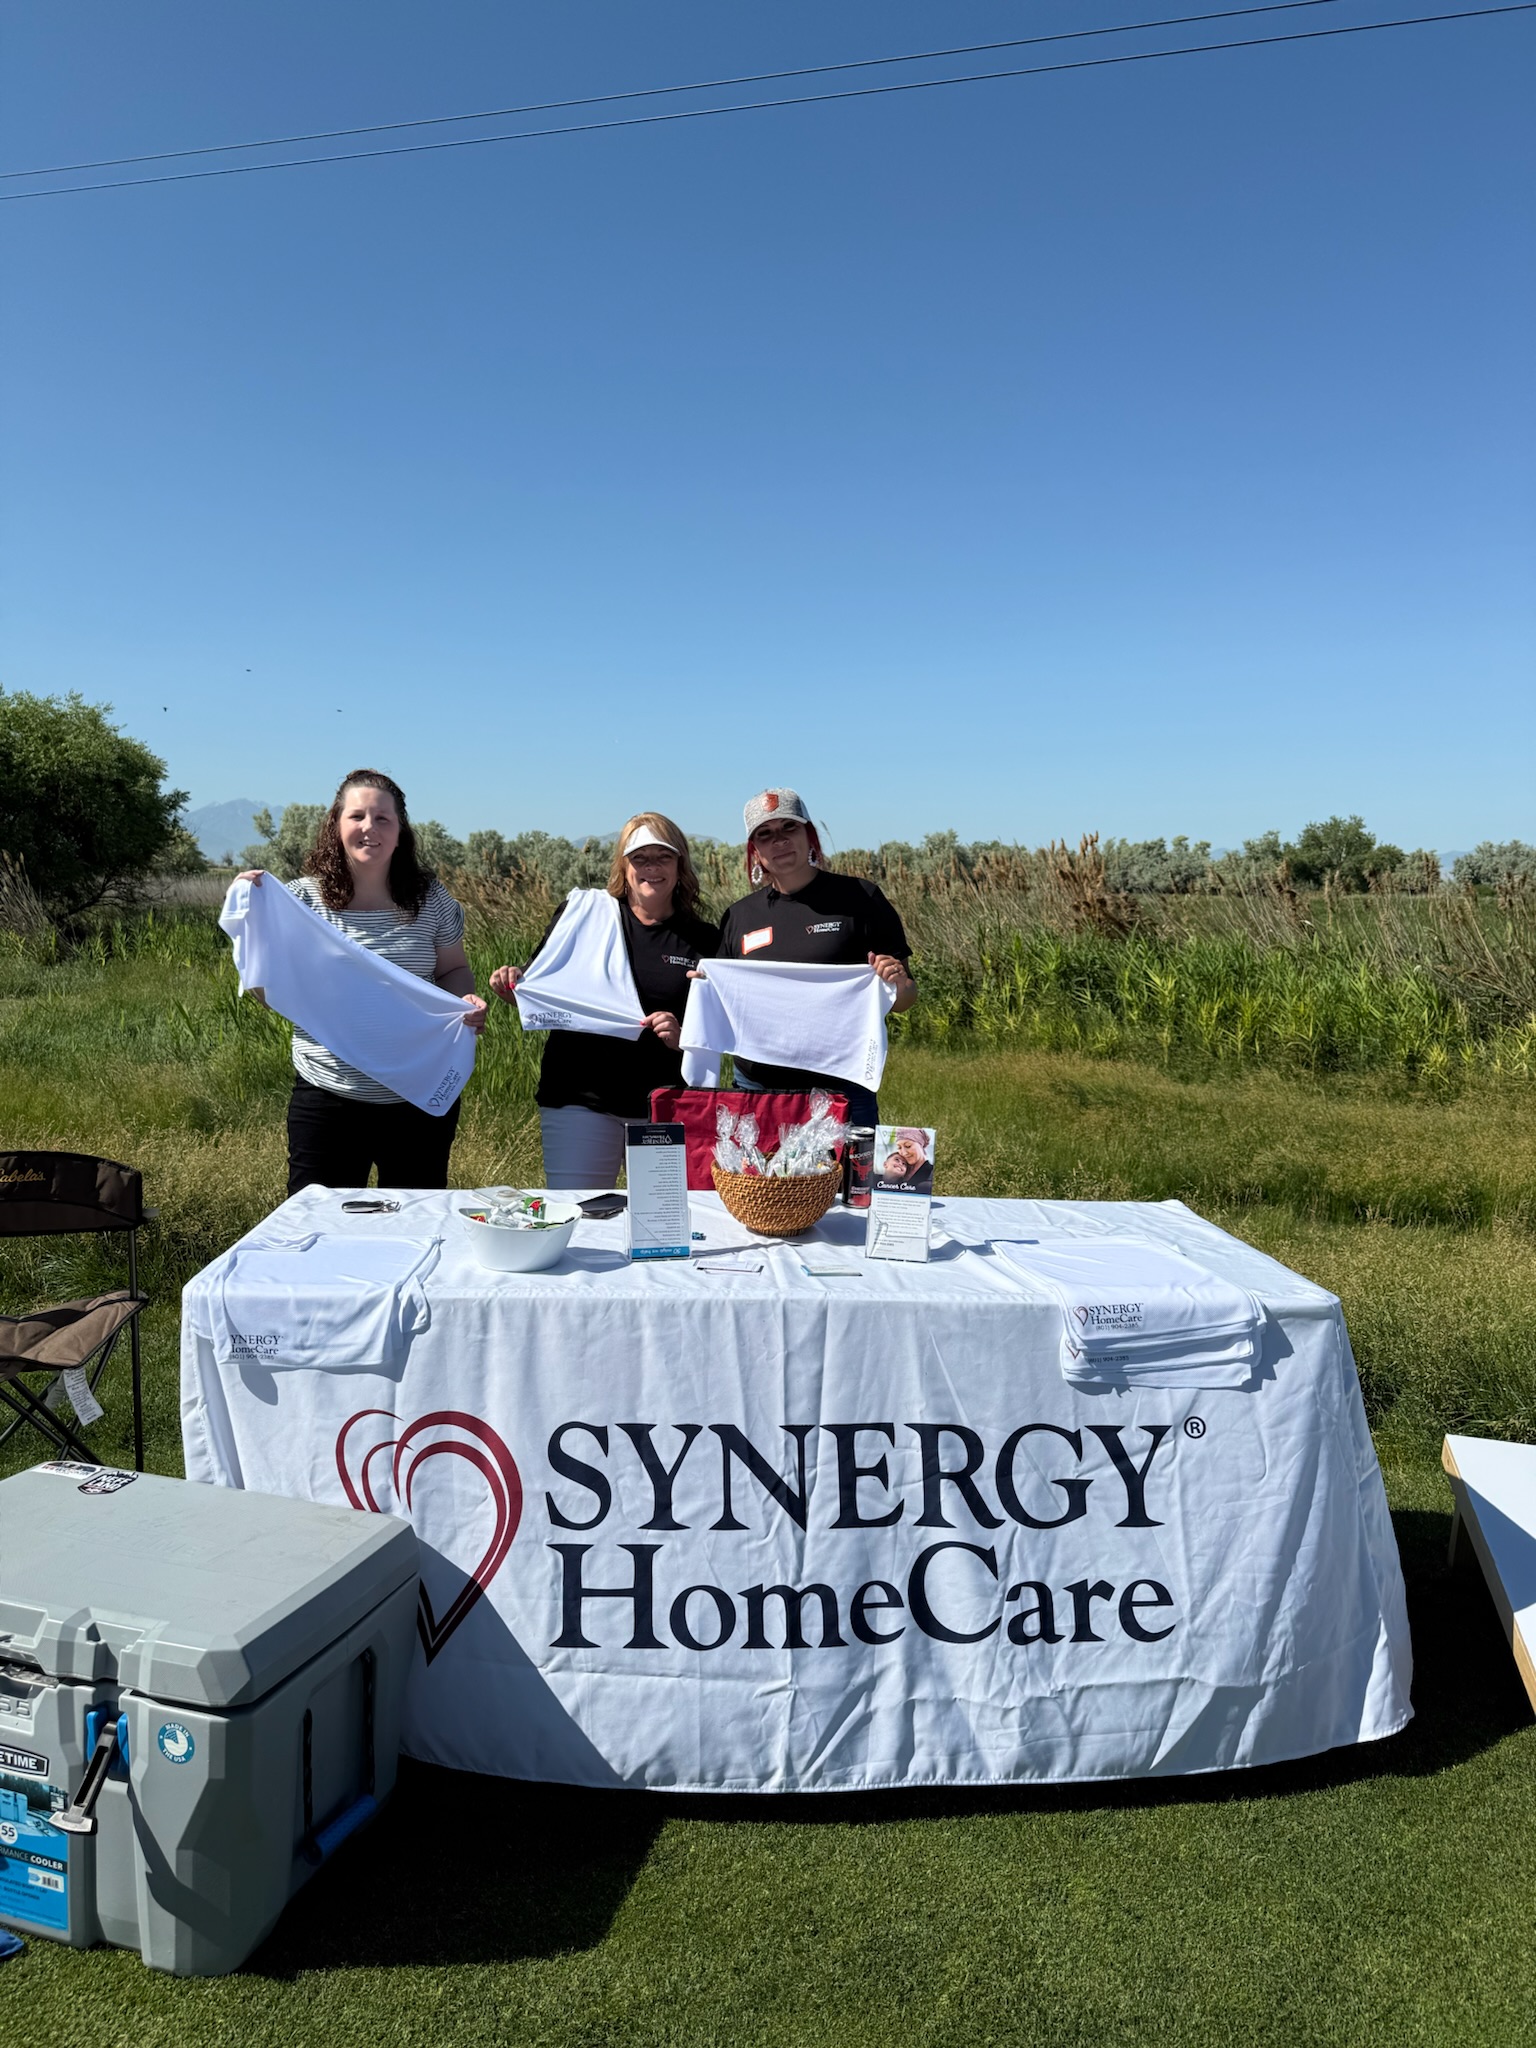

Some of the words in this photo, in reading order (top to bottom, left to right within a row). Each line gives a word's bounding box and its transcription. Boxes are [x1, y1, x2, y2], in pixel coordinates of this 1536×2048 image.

[538, 1011, 572, 1019] SYNERGY
[433, 1068, 455, 1098] SYNERGY
[877, 1180, 899, 1190] Cancer
[900, 1182, 916, 1191] Care
[1088, 1303, 1144, 1316] SYNERGY
[1090, 1313, 1143, 1325] HomeCare
[546, 1540, 1176, 1651] HomeCare
[165, 1723, 183, 1731] MADE
[182, 1729, 190, 1738] IN
[162, 1748, 173, 1760] THE
[1, 1825, 15, 1838] 55
[30, 1855, 64, 1871] COOLER
